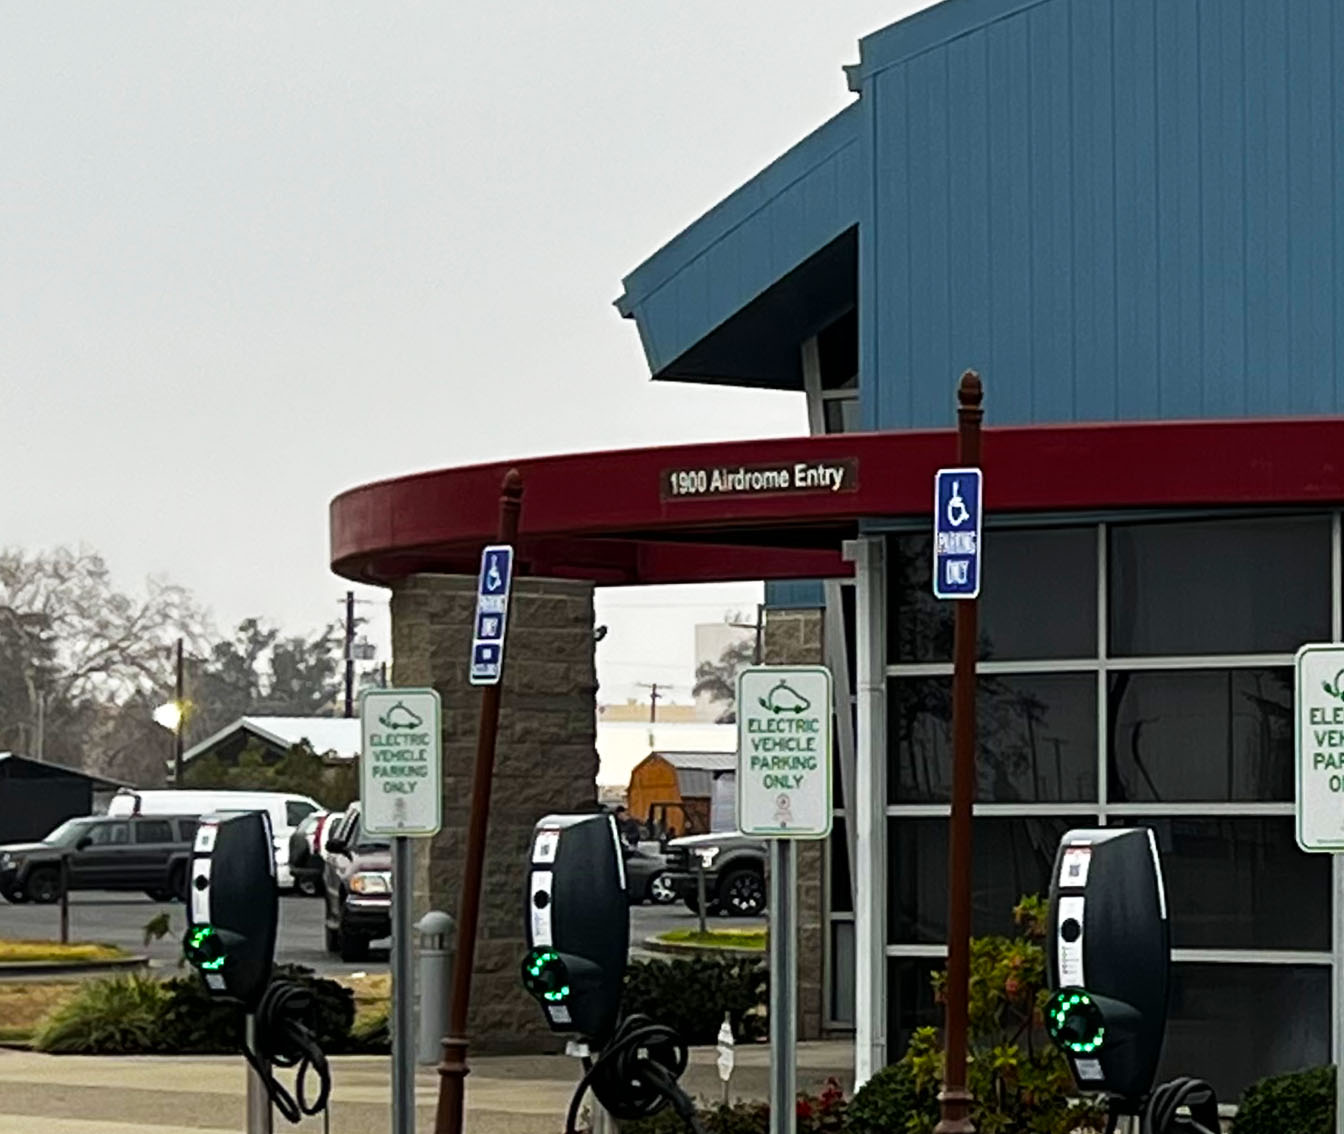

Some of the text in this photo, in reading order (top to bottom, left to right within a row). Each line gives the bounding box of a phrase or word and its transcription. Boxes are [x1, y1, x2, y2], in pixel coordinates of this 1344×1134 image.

[671, 464, 844, 494] 1900 Airdrome Entry
[748, 718, 819, 733] ELECTRIC
[370, 733, 430, 747] ELECTRIC
[751, 737, 816, 751] VEHICLE
[372, 749, 427, 762] VEHICLE
[750, 755, 817, 770] PARKING
[372, 765, 428, 778] PARKING
[384, 781, 417, 794] ONLY
[763, 774, 803, 789] ONLY
